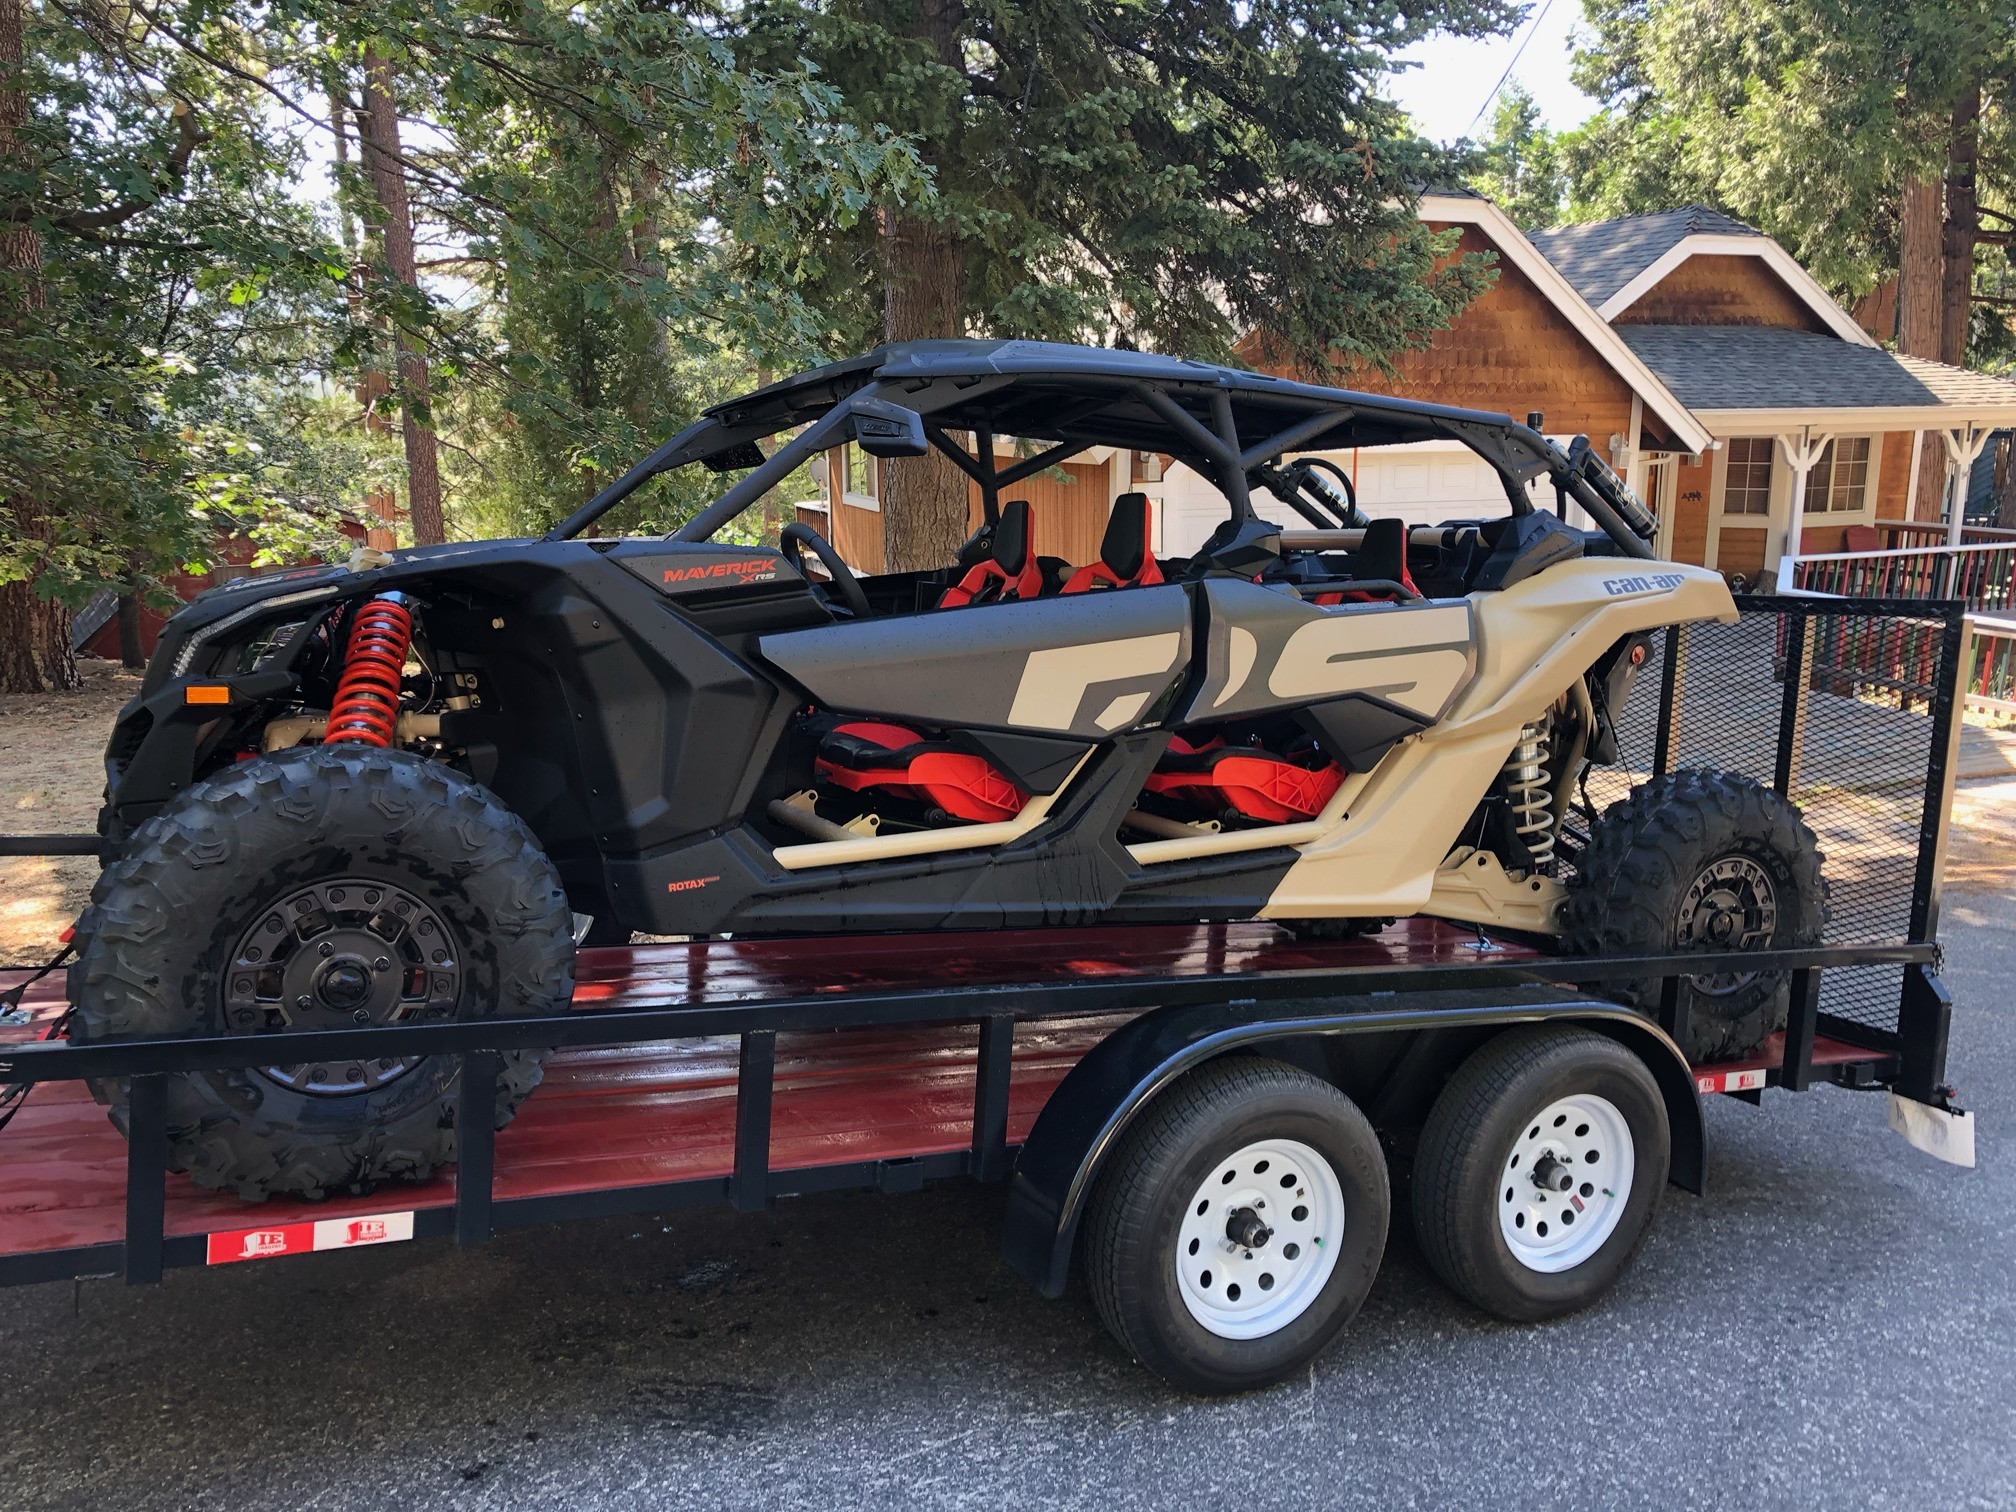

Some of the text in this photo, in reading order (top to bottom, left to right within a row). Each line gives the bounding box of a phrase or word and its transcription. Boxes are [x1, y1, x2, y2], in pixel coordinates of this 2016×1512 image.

[663, 558, 777, 583] MAVERICK
[1602, 574, 1686, 596] can-am
[668, 879, 706, 892] ROTAX
[360, 1220, 384, 1233] IE
[258, 1233, 282, 1245] IE
